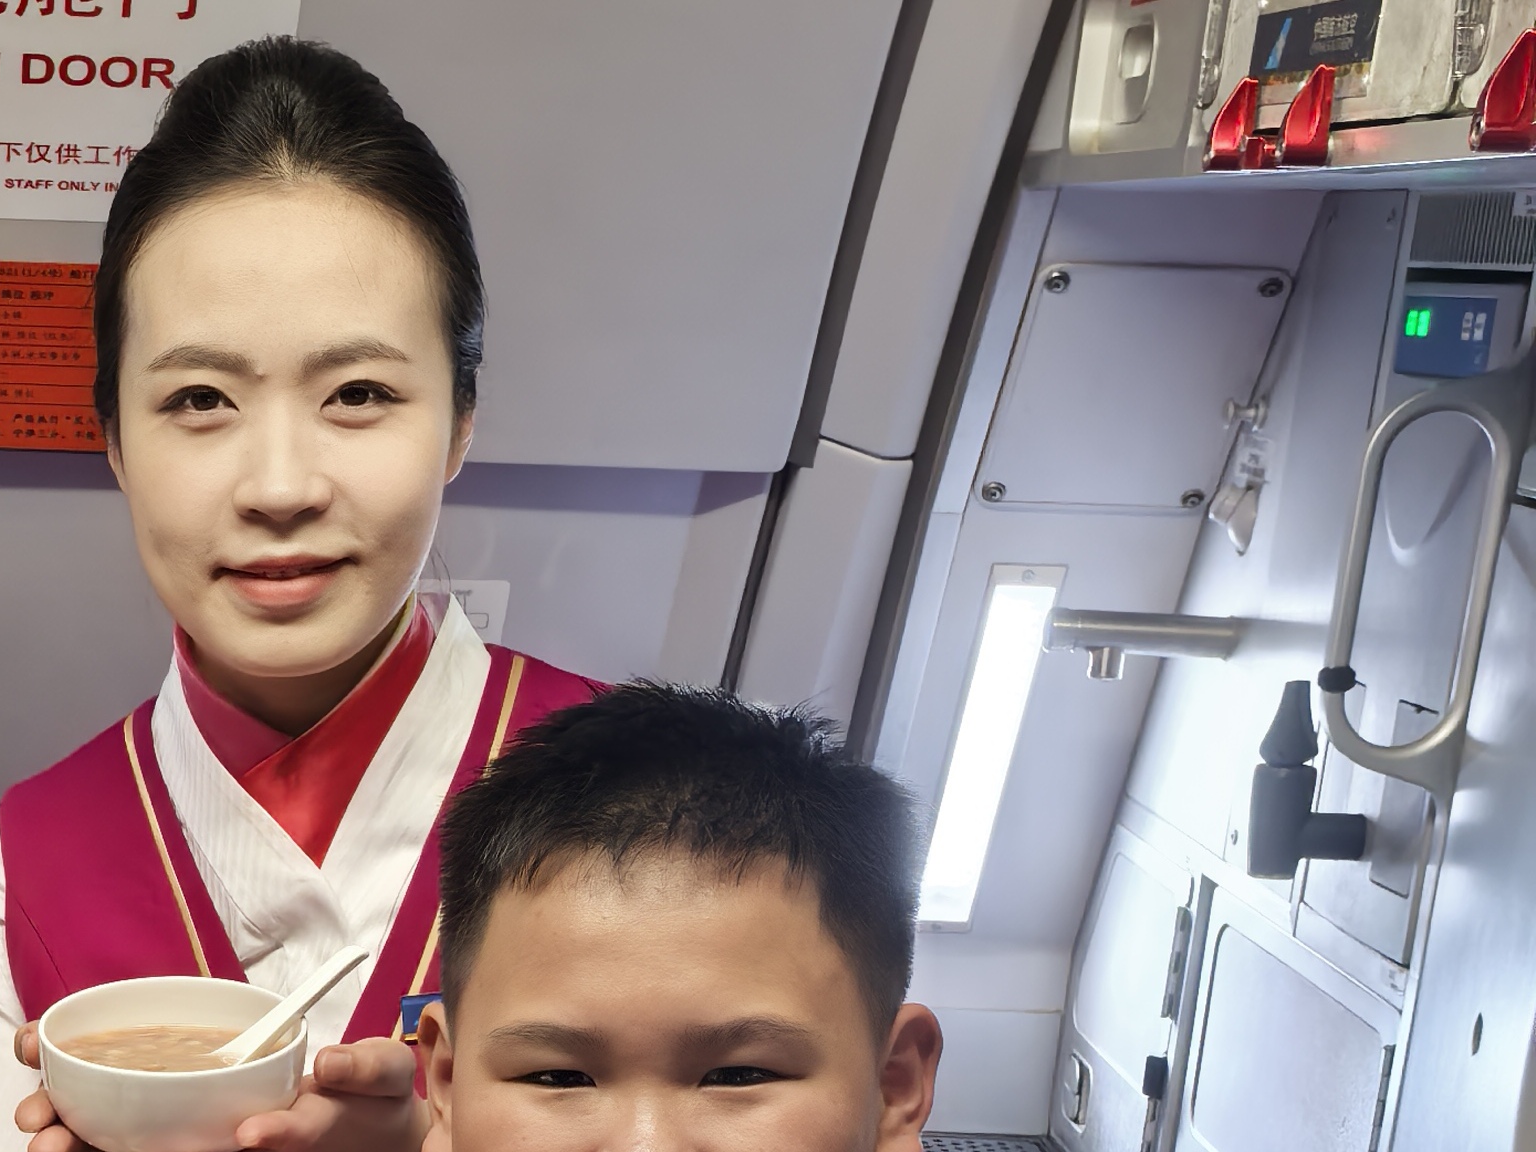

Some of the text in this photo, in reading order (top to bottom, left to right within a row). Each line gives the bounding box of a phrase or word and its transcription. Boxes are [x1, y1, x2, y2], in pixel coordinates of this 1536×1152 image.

[21, 52, 177, 90] DOOR
[4, 178, 54, 190] STAFF
[57, 180, 101, 192] ONLY
